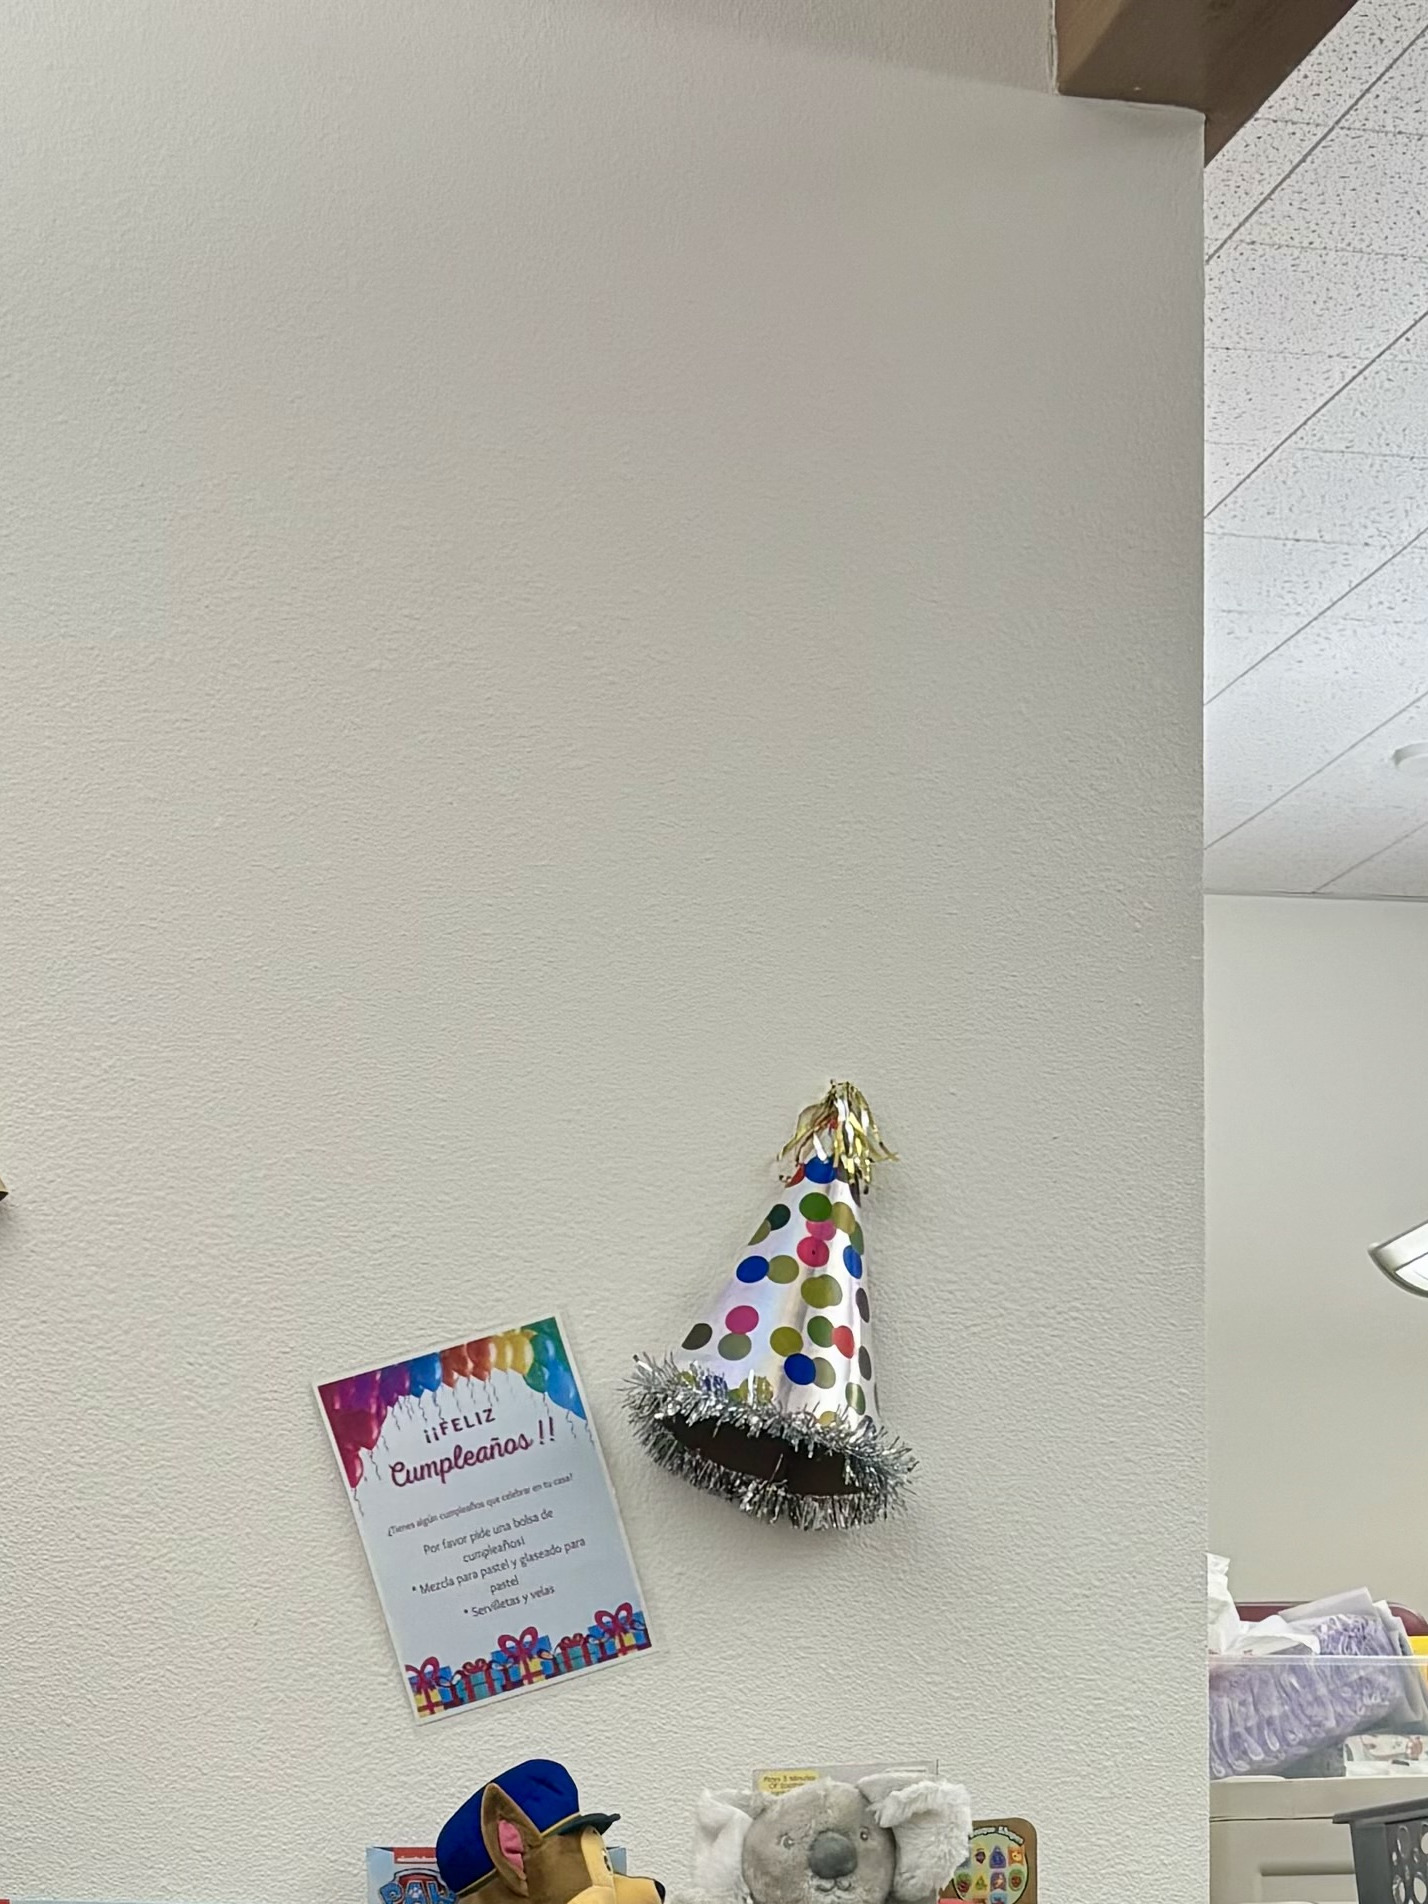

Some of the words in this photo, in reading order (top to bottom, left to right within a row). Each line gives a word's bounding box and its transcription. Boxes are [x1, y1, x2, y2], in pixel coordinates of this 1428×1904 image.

[388, 1432, 534, 1488] Cumpleaños
[439, 1500, 486, 1522] cumpleaños
[486, 1496, 501, 1508] que
[501, 1486, 531, 1503] celebrar
[422, 1543, 441, 1556] Por
[442, 1534, 468, 1550] favor
[469, 1528, 493, 1545] pide
[492, 1523, 513, 1535] una
[513, 1512, 540, 1528] bolsa
[540, 1507, 555, 1521] de
[419, 1577, 456, 1595] Mezcla
[456, 1569, 479, 1586] para
[480, 1557, 511, 1580] pastel
[519, 1545, 563, 1569] glaseado
[563, 1537, 587, 1555] para
[490, 1575, 520, 1596] pastel
[531, 1584, 556, 1600] velas
